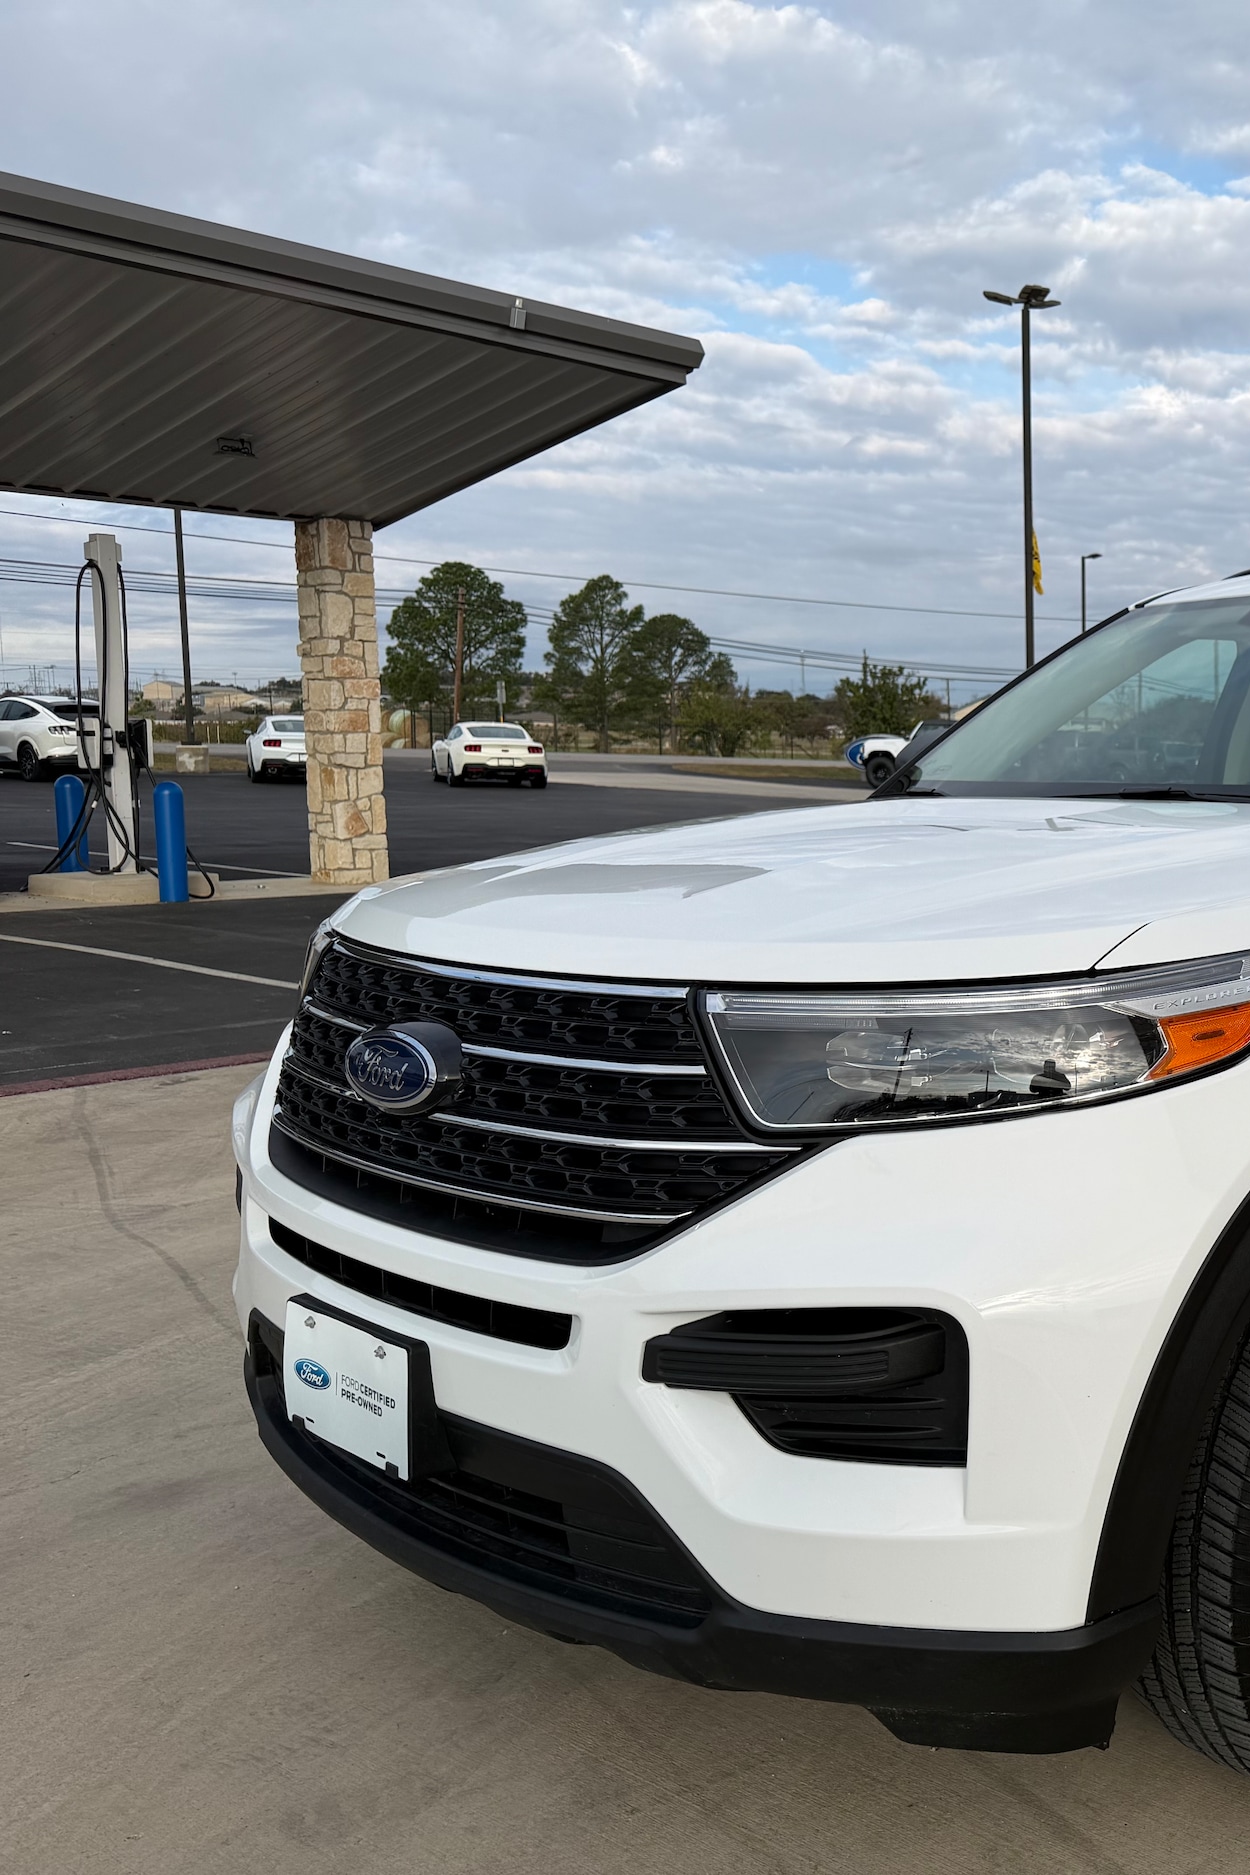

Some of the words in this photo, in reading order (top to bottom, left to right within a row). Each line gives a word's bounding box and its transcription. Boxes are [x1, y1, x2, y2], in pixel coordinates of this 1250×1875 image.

[355, 1044, 409, 1091] Ford
[300, 1361, 324, 1387] Ford
[341, 1388, 383, 1417] PRE-OWNED
